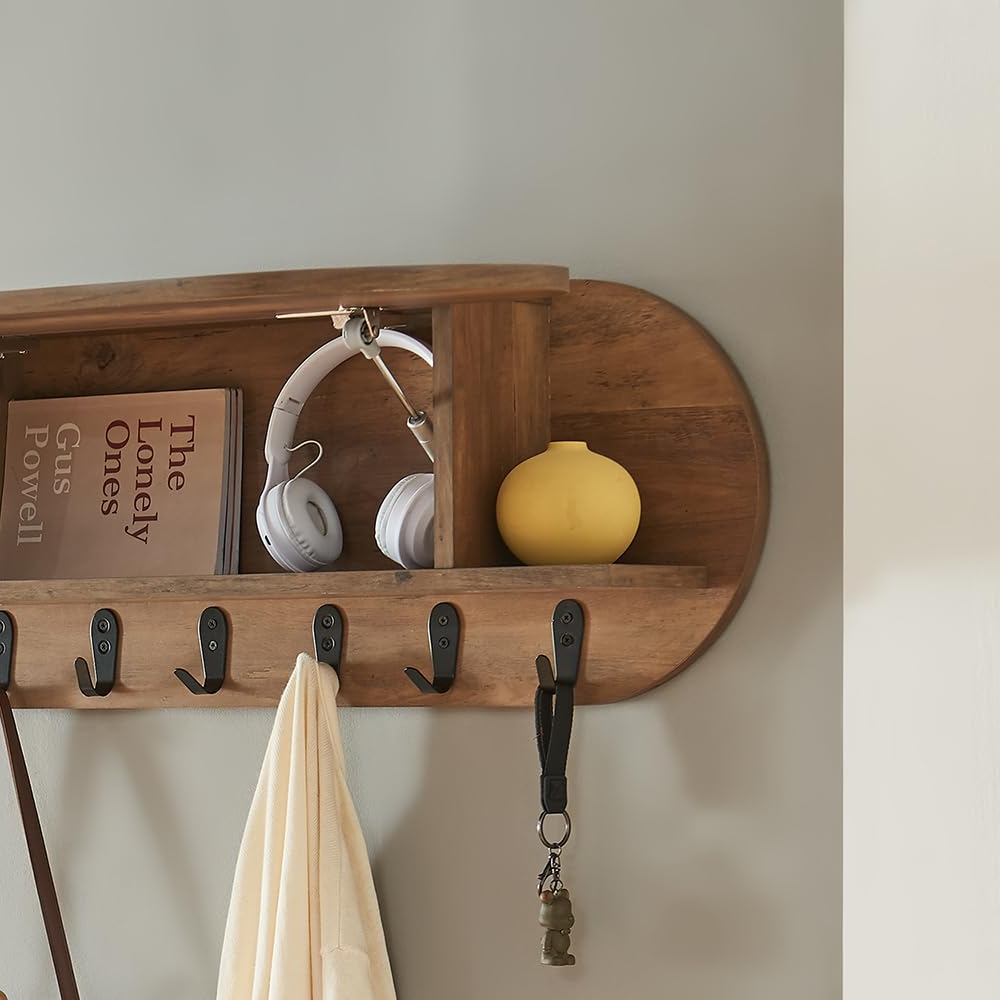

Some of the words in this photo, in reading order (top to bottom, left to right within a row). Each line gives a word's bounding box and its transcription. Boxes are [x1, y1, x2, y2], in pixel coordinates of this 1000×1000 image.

[16, 425, 49, 546] Powell
[53, 422, 81, 495] Gus
[101, 419, 130, 516] Ones
[125, 417, 162, 544] Lonely
[168, 414, 195, 491] The
